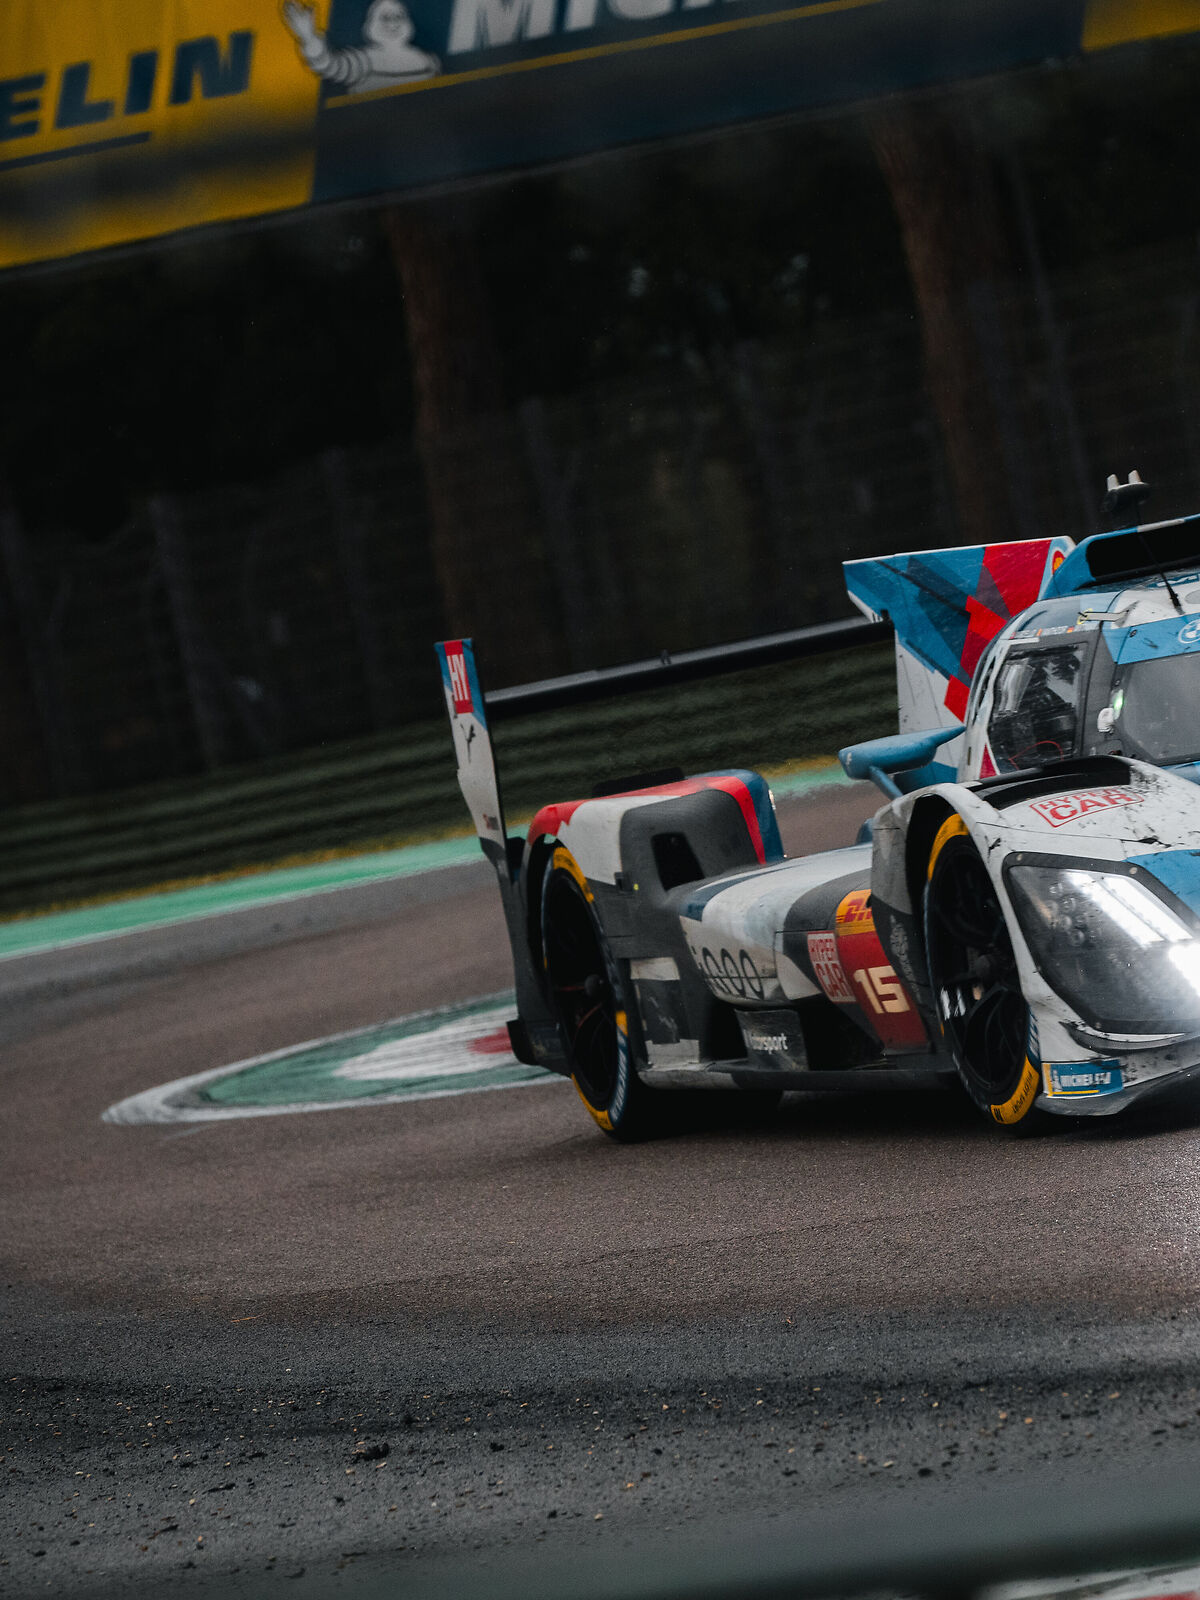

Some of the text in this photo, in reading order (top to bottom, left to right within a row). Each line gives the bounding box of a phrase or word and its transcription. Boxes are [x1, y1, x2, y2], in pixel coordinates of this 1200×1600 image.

[446, 653, 469, 701] HY
[1049, 793, 1134, 820] CAR
[814, 963, 851, 998] CAR
[853, 965, 910, 1014] 15
